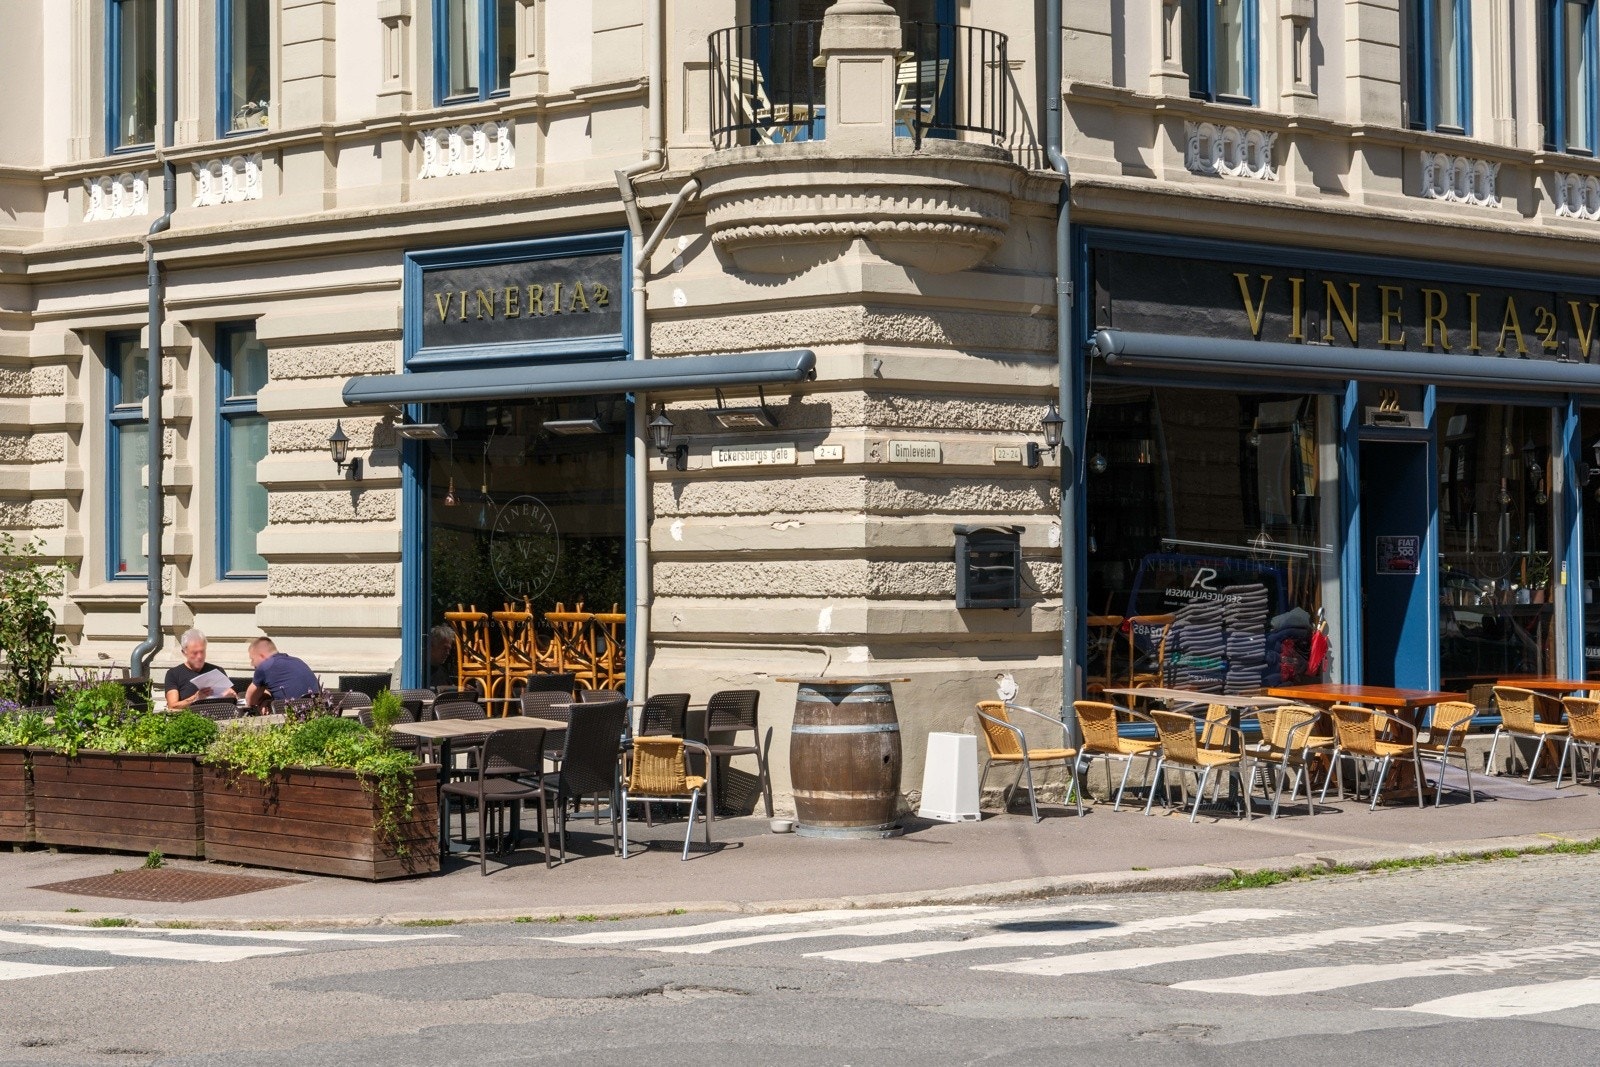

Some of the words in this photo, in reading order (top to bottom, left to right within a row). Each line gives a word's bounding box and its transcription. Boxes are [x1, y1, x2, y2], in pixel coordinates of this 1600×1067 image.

[1379, 388, 1400, 412] 22
[718, 448, 768, 463] Eckersbergs
[895, 443, 936, 458] Gimleveien
[998, 449, 1018, 459] 22-24
[496, 503, 552, 534] VINERIA
[1398, 538, 1415, 546] FIAT
[1128, 558, 1194, 572] VINERIA
